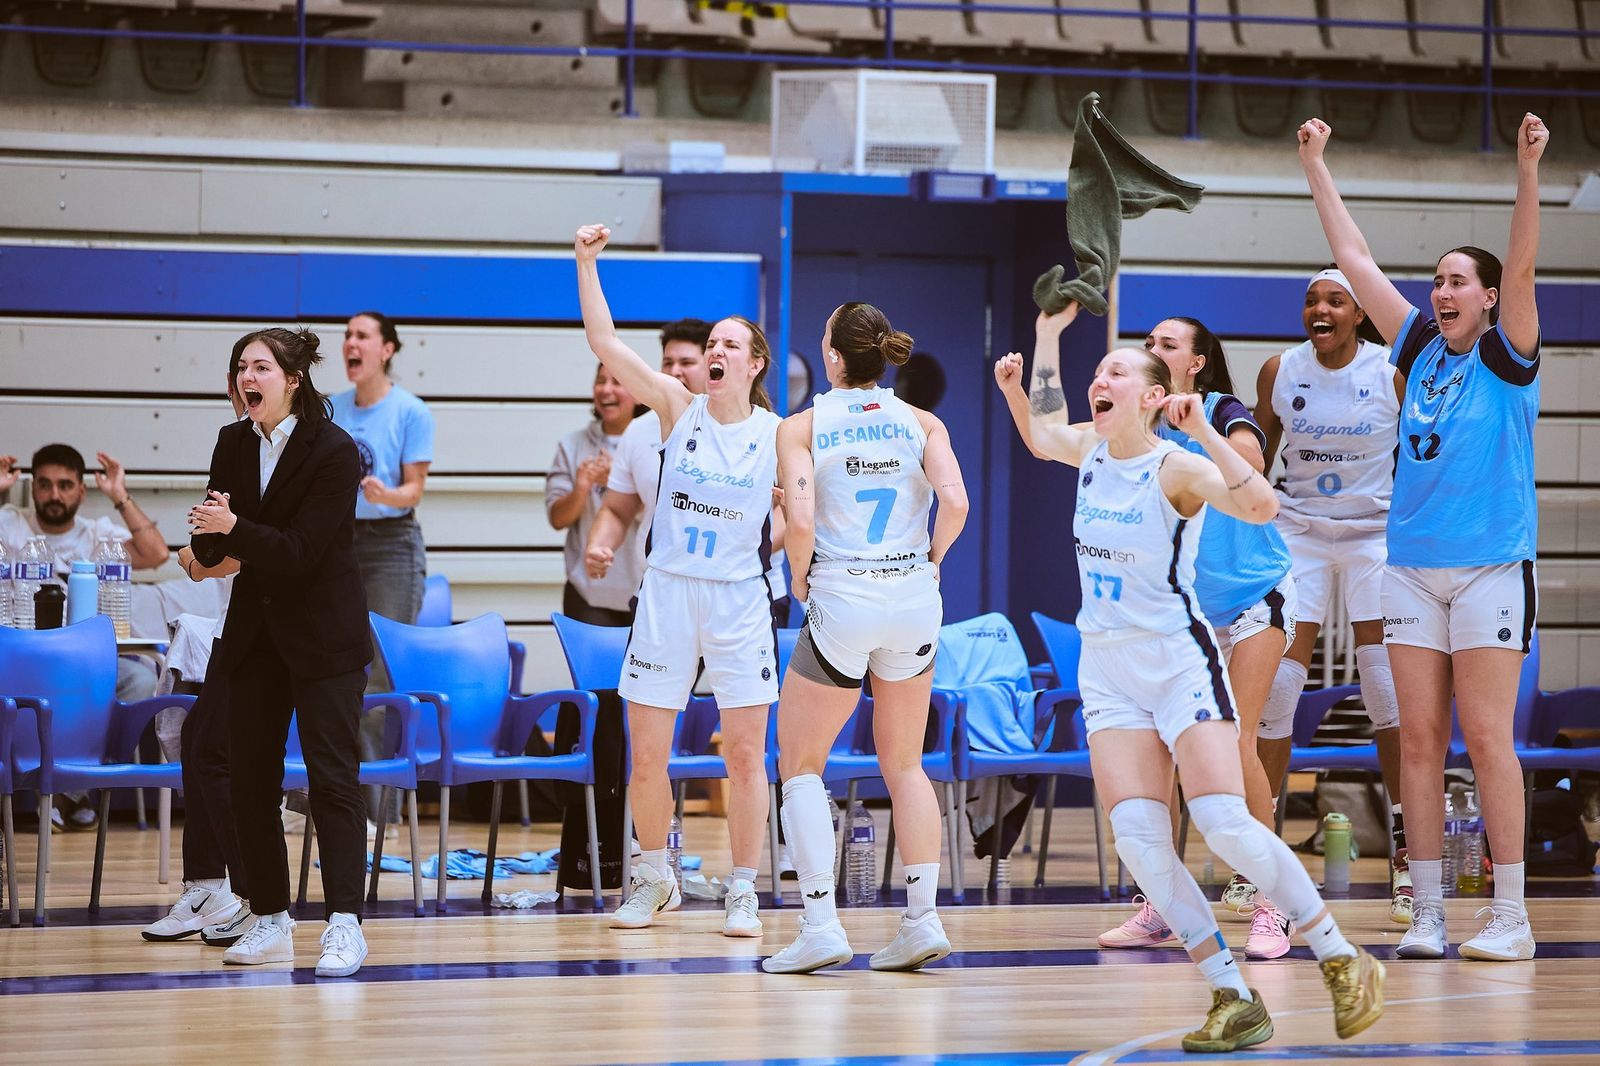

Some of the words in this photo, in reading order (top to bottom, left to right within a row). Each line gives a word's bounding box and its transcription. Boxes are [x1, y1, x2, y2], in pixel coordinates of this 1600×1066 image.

[816, 431, 841, 450] DE
[1291, 418, 1372, 440] Leganés
[1408, 432, 1441, 461] 12
[675, 458, 754, 489] Leganés
[861, 458, 900, 470] Leganés
[1317, 473, 1342, 496] 0
[671, 491, 744, 521] innova-tsn
[855, 487, 898, 545] 7
[684, 526, 717, 559] 11
[1087, 570, 1123, 602] 77
